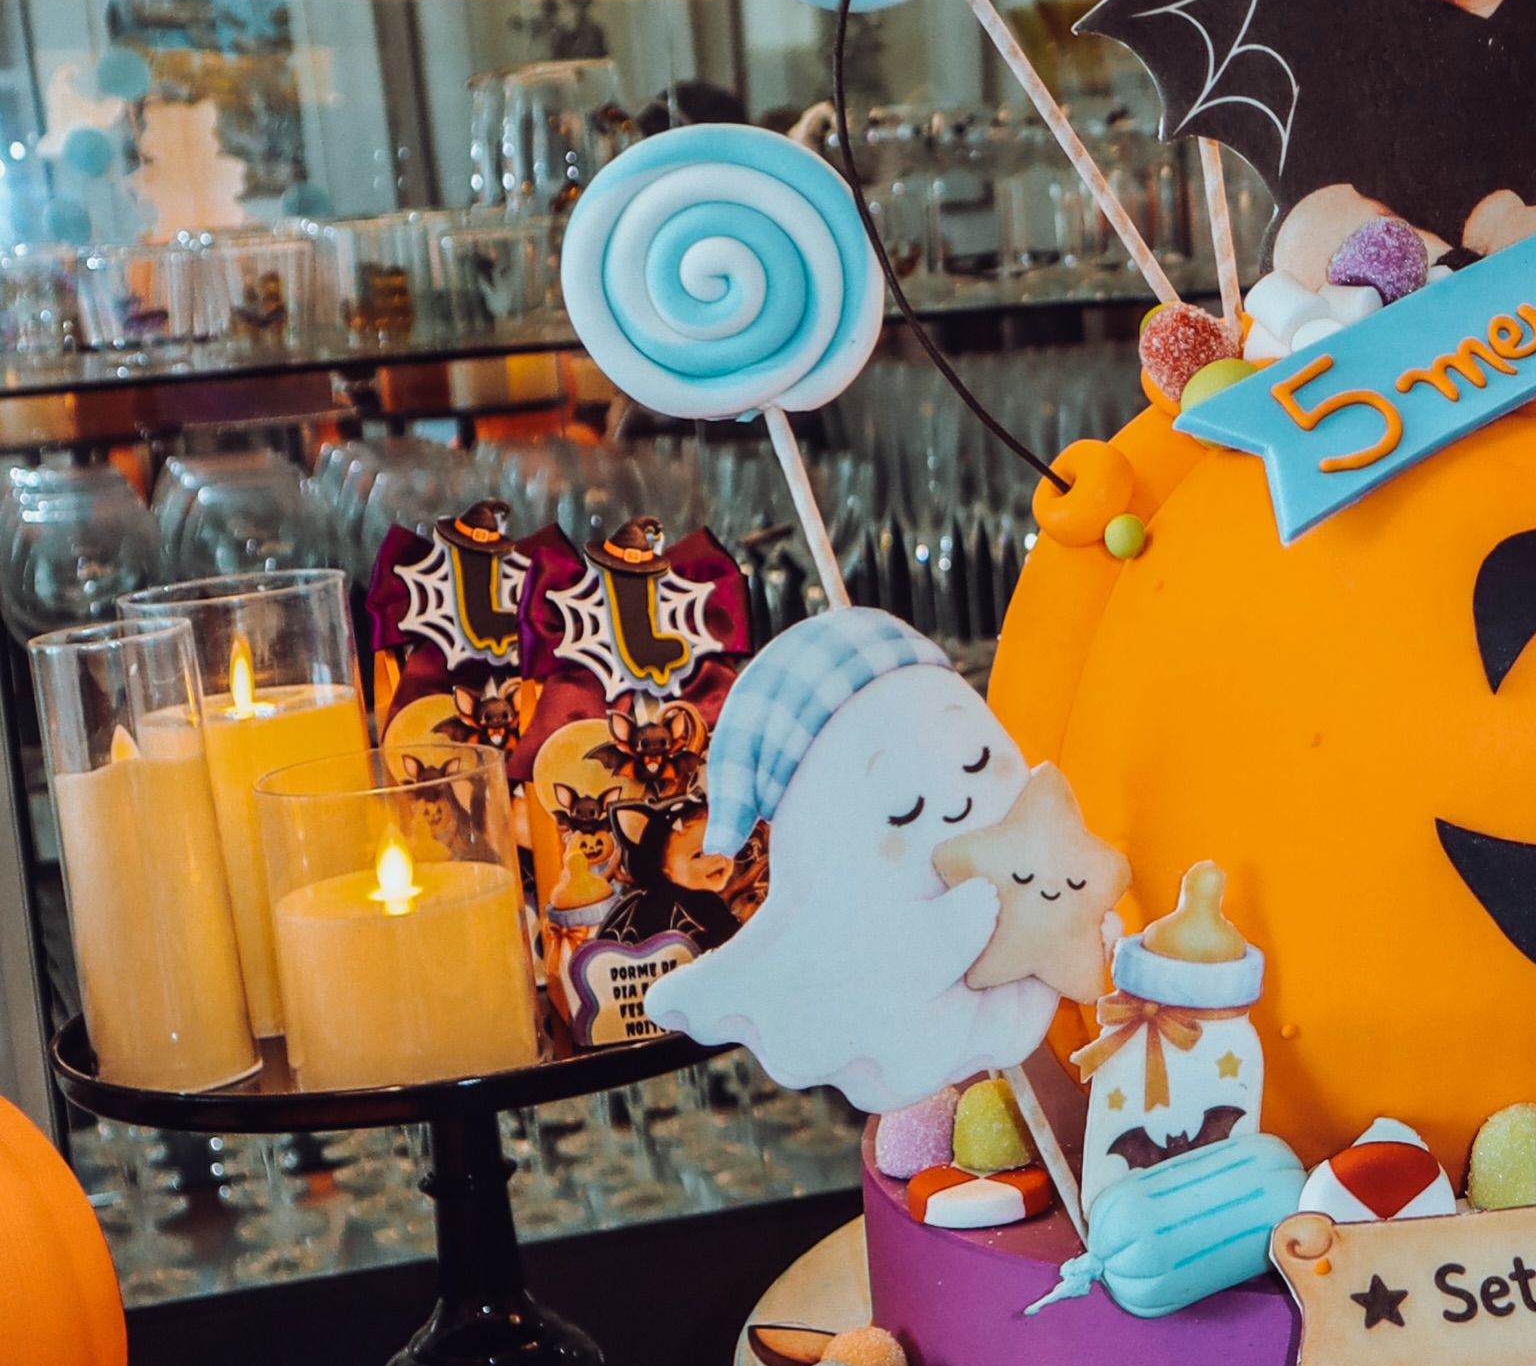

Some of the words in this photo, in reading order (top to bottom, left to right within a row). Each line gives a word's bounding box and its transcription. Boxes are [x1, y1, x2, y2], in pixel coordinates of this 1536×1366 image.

[1271, 353, 1404, 473] 5
[610, 962, 657, 981] DORME
[613, 984, 637, 1000] DIA
